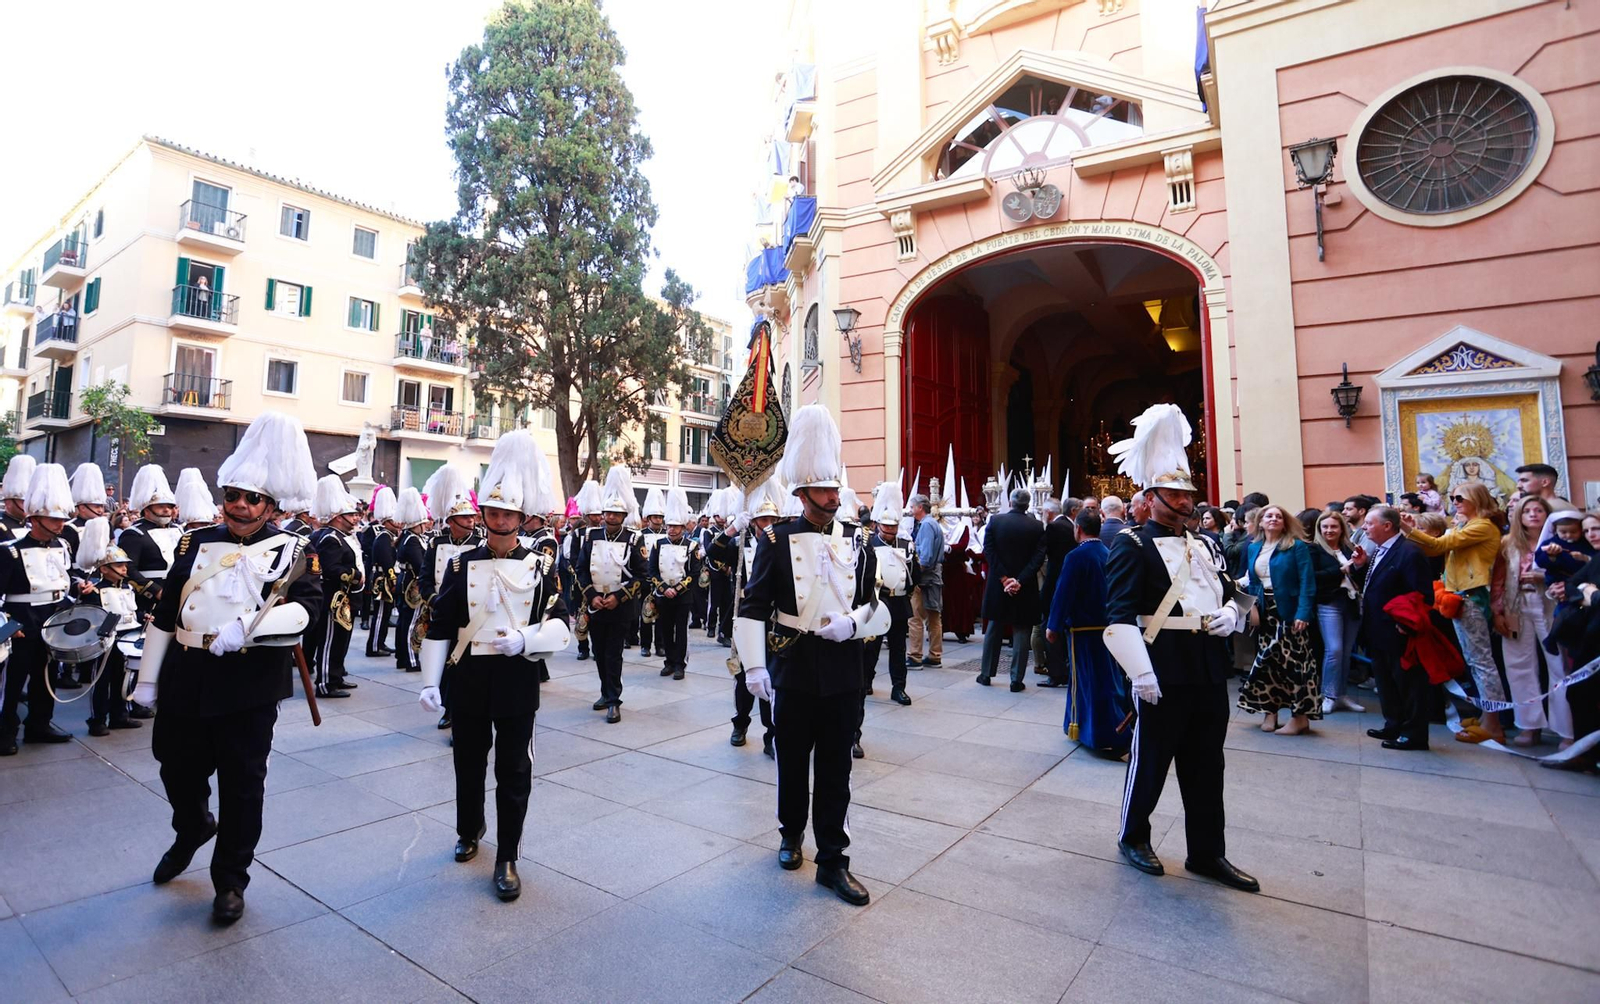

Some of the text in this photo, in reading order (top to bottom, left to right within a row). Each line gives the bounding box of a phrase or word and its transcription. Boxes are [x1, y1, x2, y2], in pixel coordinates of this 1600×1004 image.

[891, 225, 1218, 323] CAPILLA DE JESUS DE LA PUENTE DEL CEDRON Y MARIA STMA DE LA PALOMA
